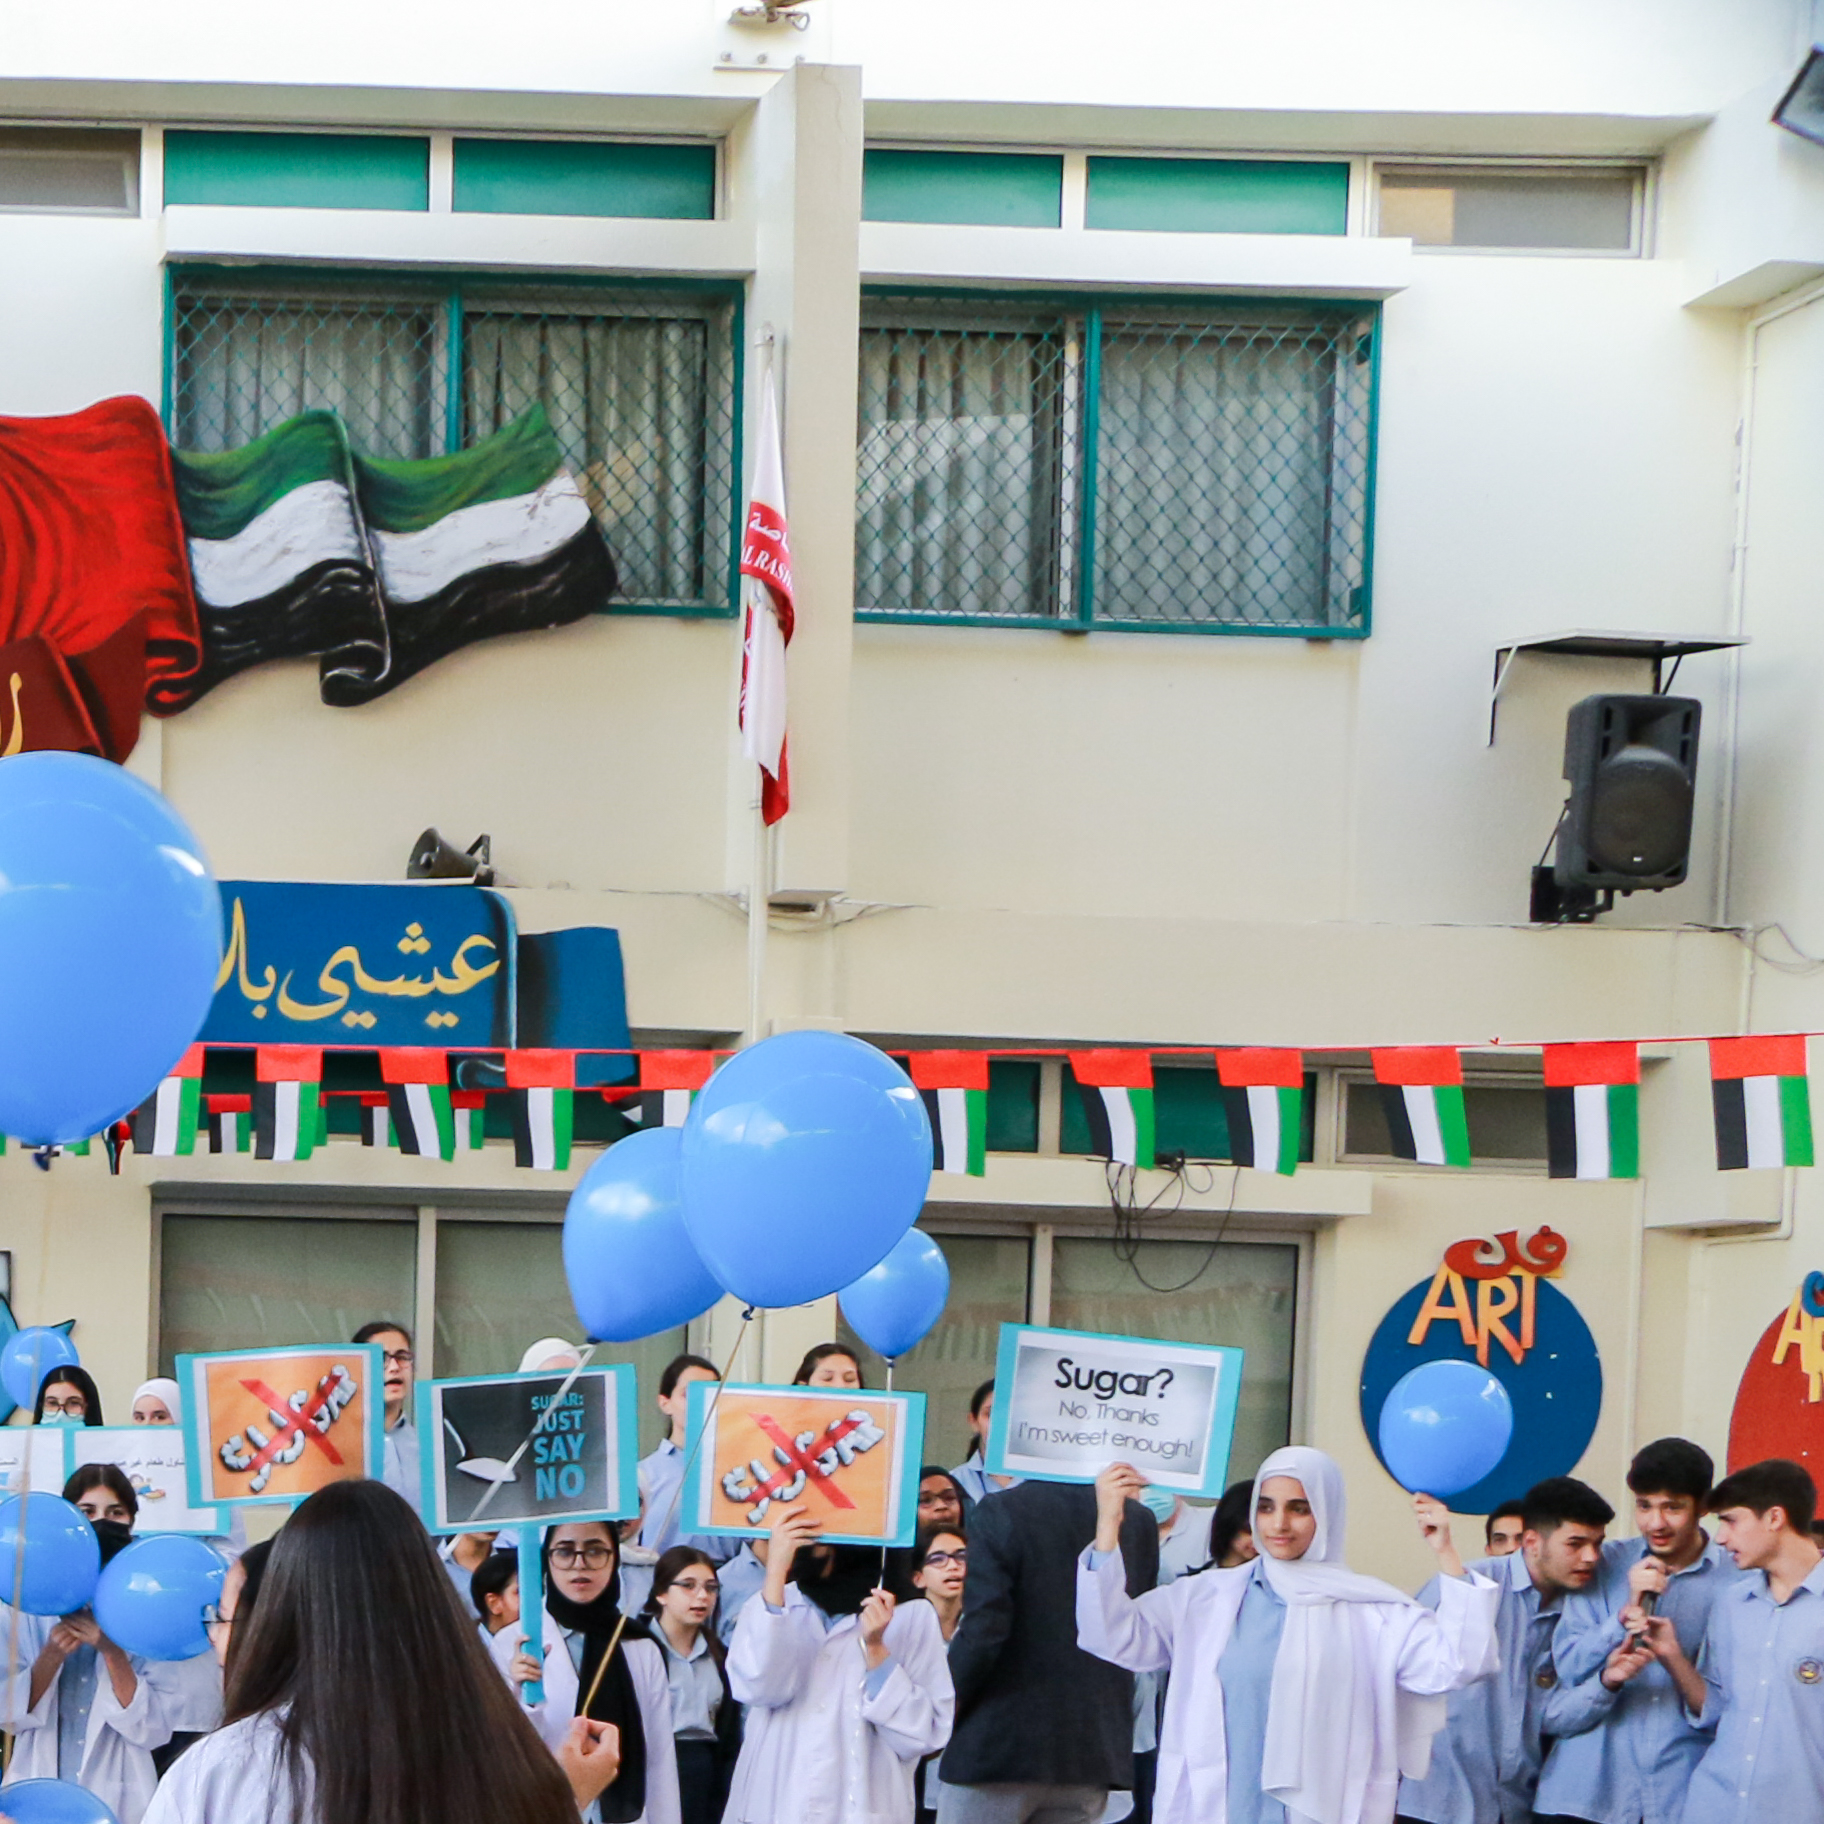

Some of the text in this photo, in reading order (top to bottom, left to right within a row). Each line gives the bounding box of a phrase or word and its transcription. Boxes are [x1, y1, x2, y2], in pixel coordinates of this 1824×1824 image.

[277, 922, 501, 1029] عيشي
[1407, 1262, 1564, 1367] ART
[1055, 1357, 1174, 1400] Sugar?
[1059, 1400, 1160, 1426] No, Thanks
[533, 1433, 586, 1464] SAY
[1018, 1423, 1193, 1460] I'm sweet enough!
[536, 1464, 586, 1501] NO
